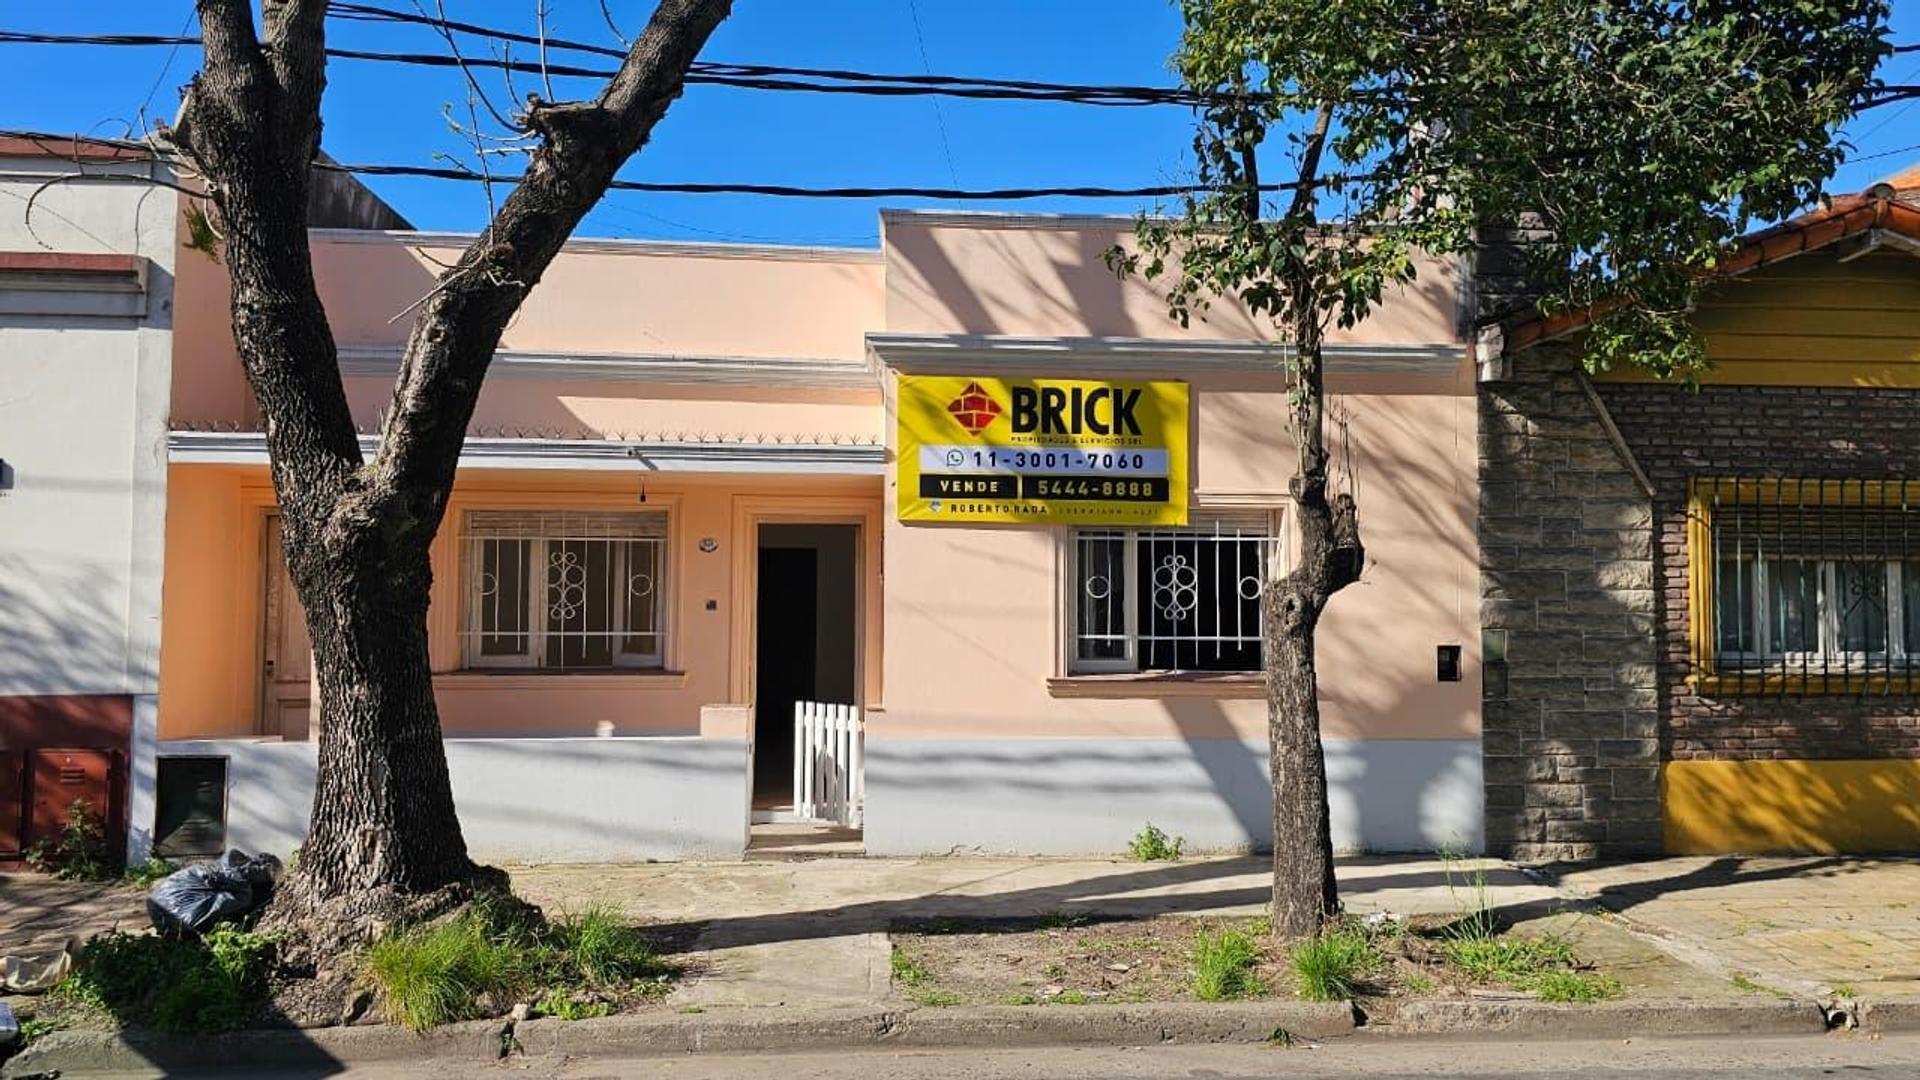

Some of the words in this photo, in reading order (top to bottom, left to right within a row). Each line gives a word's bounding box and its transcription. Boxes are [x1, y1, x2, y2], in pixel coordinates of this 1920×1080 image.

[1011, 386, 1142, 435] BRICK
[973, 451, 1144, 469] 11-3001-7060
[940, 480, 999, 492] VENDE
[1038, 481, 1153, 496] 5444-8888
[951, 503, 1009, 513] ROBERTO
[1014, 504, 1048, 514] RADA
